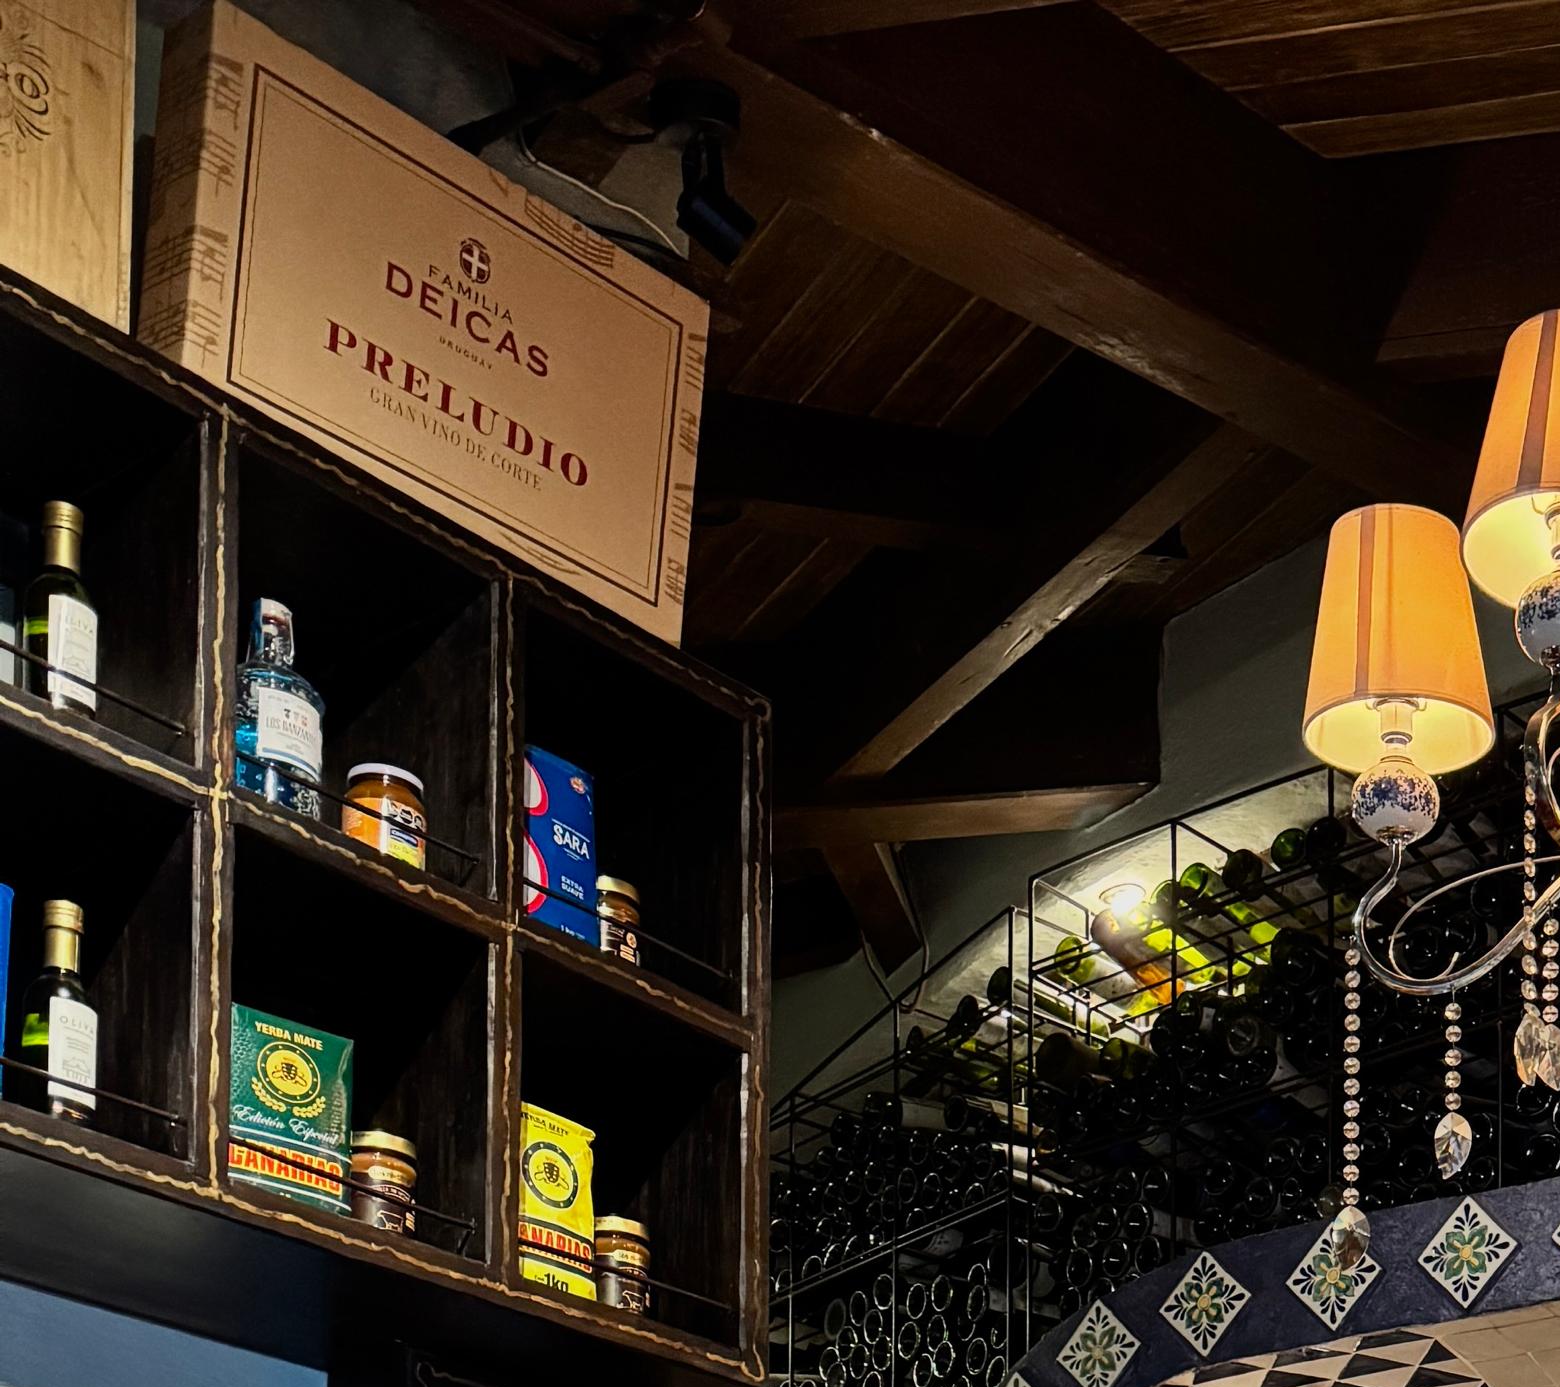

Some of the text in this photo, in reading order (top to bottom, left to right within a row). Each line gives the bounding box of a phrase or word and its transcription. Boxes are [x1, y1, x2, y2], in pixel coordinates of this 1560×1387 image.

[428, 264, 513, 324] FAMILIA
[385, 261, 549, 377] DEICAS
[439, 335, 493, 370] URUGUAY
[323, 318, 588, 486] PRELUDIO
[370, 387, 542, 491] GRAN VINO DE CORTE
[553, 823, 590, 860] SARA
[561, 875, 584, 893] EXTRA
[59, 1015, 94, 1035] OLIVA
[255, 1021, 323, 1050] YERBA MATE
[233, 1104, 338, 1148] Edición Especial
[228, 1137, 344, 1196] CANARIAS
